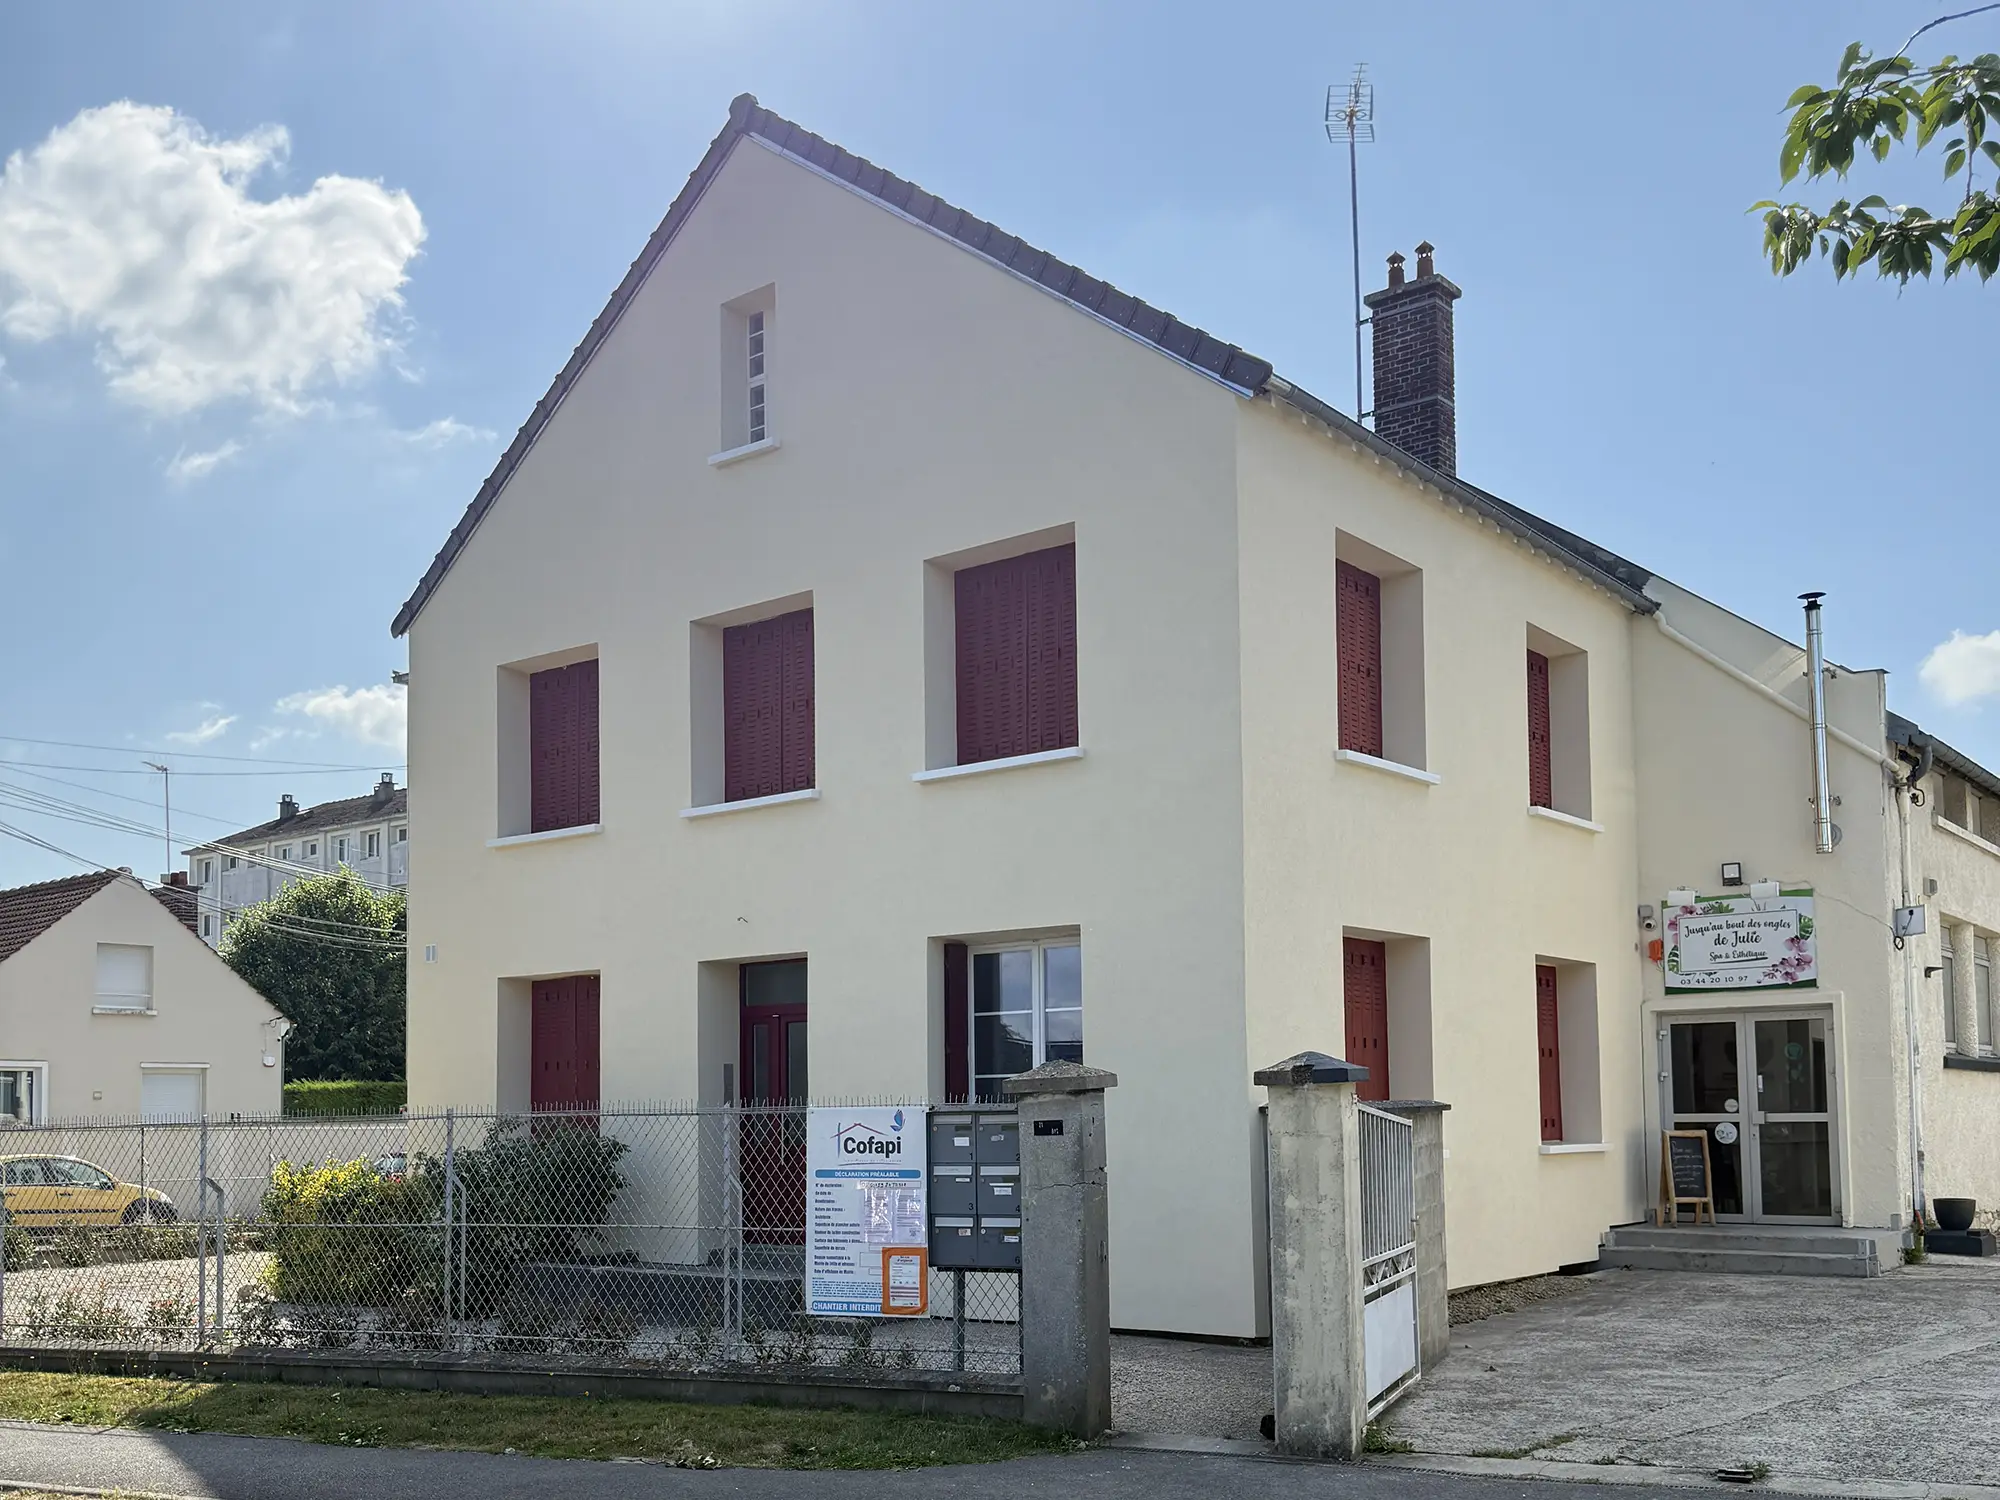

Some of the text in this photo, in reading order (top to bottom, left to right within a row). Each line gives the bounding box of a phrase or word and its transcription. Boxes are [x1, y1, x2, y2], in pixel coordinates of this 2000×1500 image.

[1684, 918, 1792, 938] Jusqu'au bout des ongles
[1714, 930, 1762, 948] de Julie
[1709, 951, 1723, 962] Spa
[843, 1135, 902, 1159] Cofapi
[969, 1152, 973, 1161] 1
[1016, 1153, 1020, 1162] 2
[870, 1170, 900, 1178] PRÉALABLE
[968, 1202, 974, 1211] 3
[1015, 1256, 1021, 1265] 6
[813, 1302, 881, 1312] CHANTIER INTERDIT
